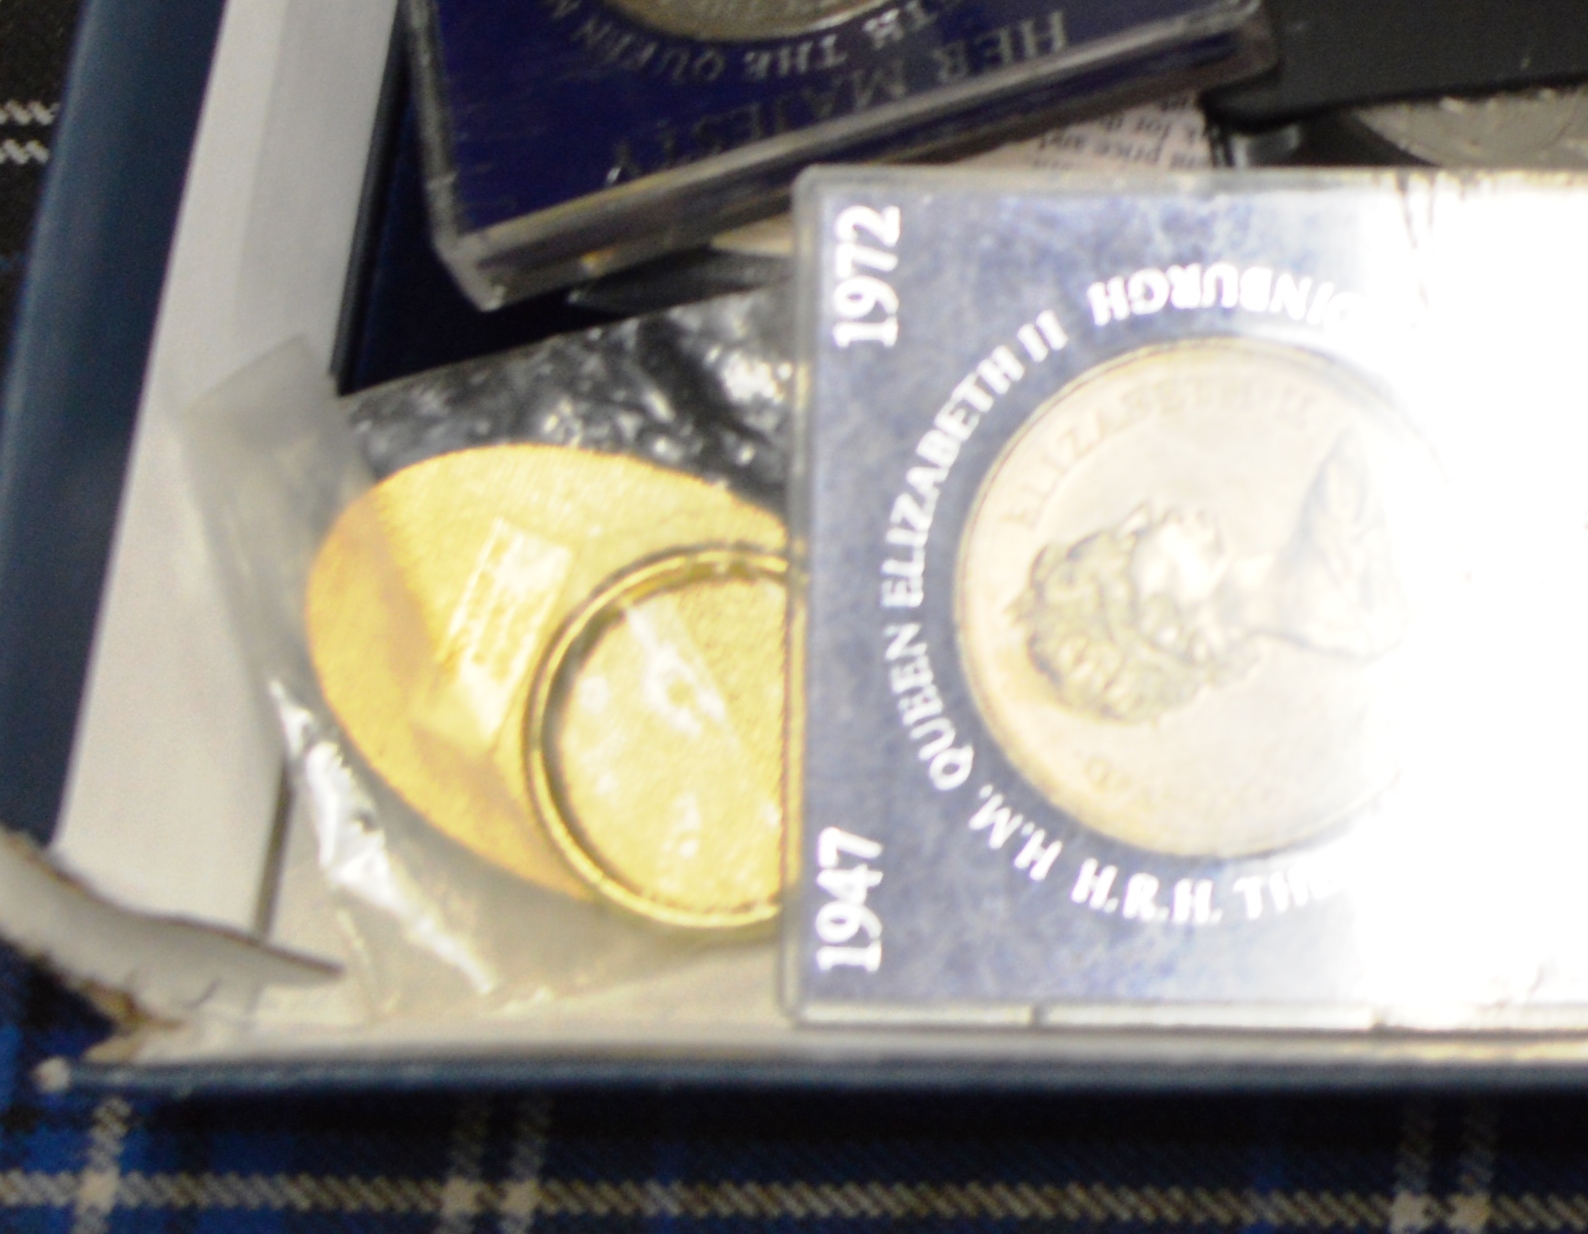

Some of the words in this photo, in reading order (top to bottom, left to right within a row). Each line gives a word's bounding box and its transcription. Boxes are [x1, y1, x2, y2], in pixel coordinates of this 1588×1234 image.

[933, 8, 1068, 85] HER
[833, 204, 902, 350] 1972
[1018, 309, 1070, 364] II
[881, 345, 1025, 610] ELIZABETH
[884, 623, 974, 793] QUEEN
[969, 783, 1065, 882] H.M.
[1070, 857, 1224, 926] H.R.H.
[815, 825, 884, 973] 1947
